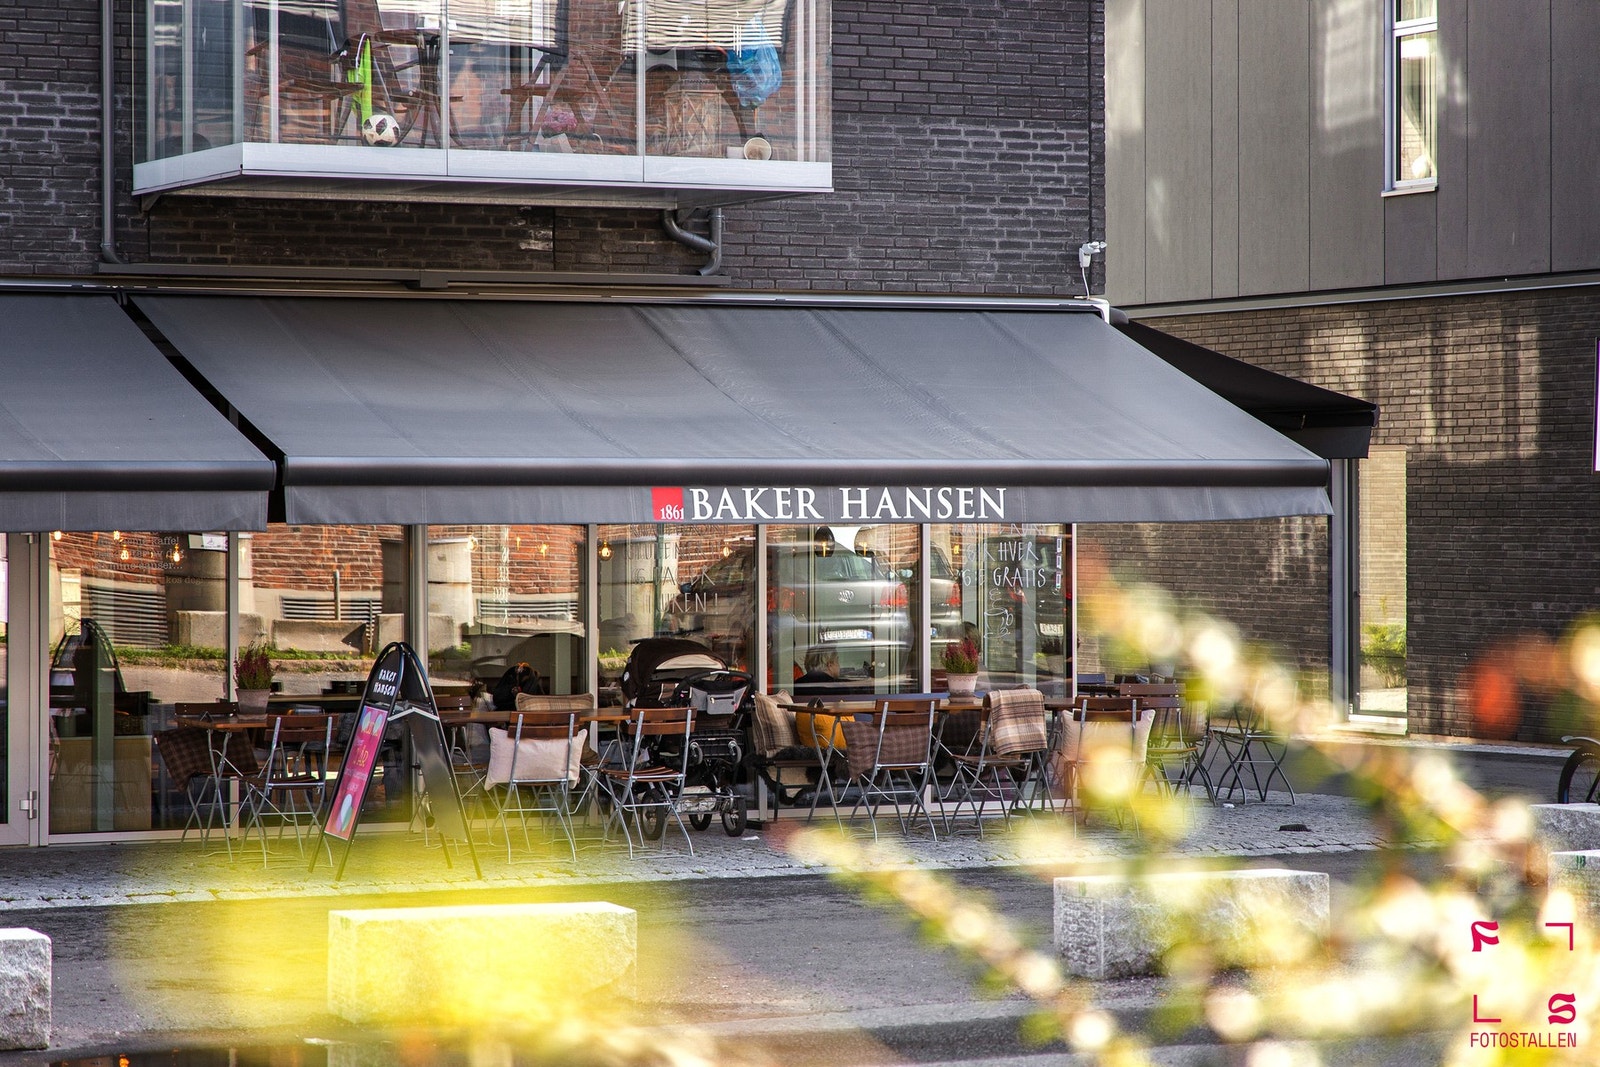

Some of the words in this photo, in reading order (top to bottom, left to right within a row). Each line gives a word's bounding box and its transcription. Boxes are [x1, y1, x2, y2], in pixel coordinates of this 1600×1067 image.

[660, 505, 685, 521] 1861
[689, 487, 824, 520] BAKER
[839, 487, 1007, 520] HANSEN
[998, 541, 1040, 562] HVER
[993, 566, 1047, 588] GRATIS
